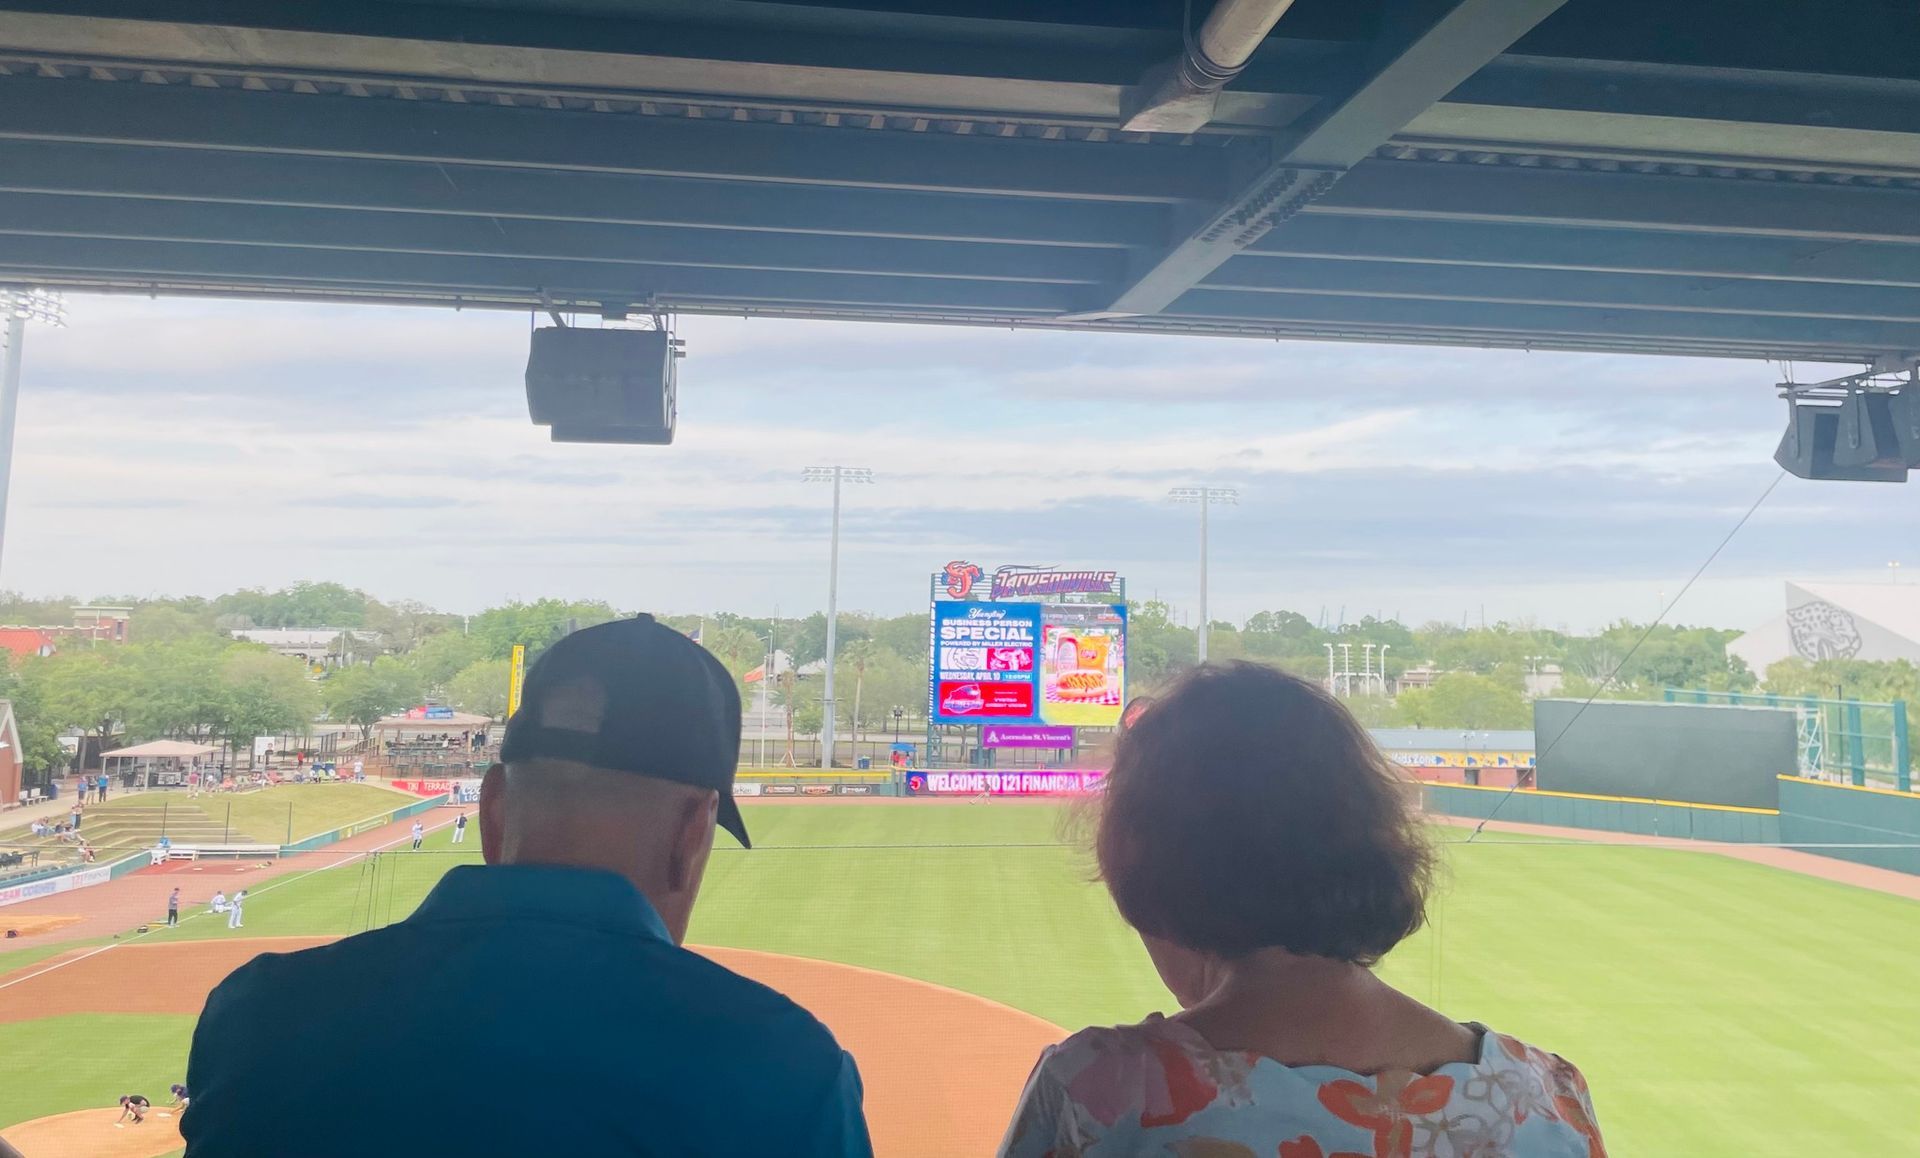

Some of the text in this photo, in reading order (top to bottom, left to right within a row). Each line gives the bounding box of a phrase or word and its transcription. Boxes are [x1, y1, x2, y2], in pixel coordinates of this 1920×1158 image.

[942, 619, 1033, 627] BUSINESS PERSON
[940, 627, 1033, 641] SPECIAL
[976, 671, 993, 681] APRIL
[927, 774, 986, 792] WELCOME
[986, 774, 1001, 792] TO
[1001, 774, 1021, 792] 121
[1022, 774, 1080, 792] FINANCIAL
